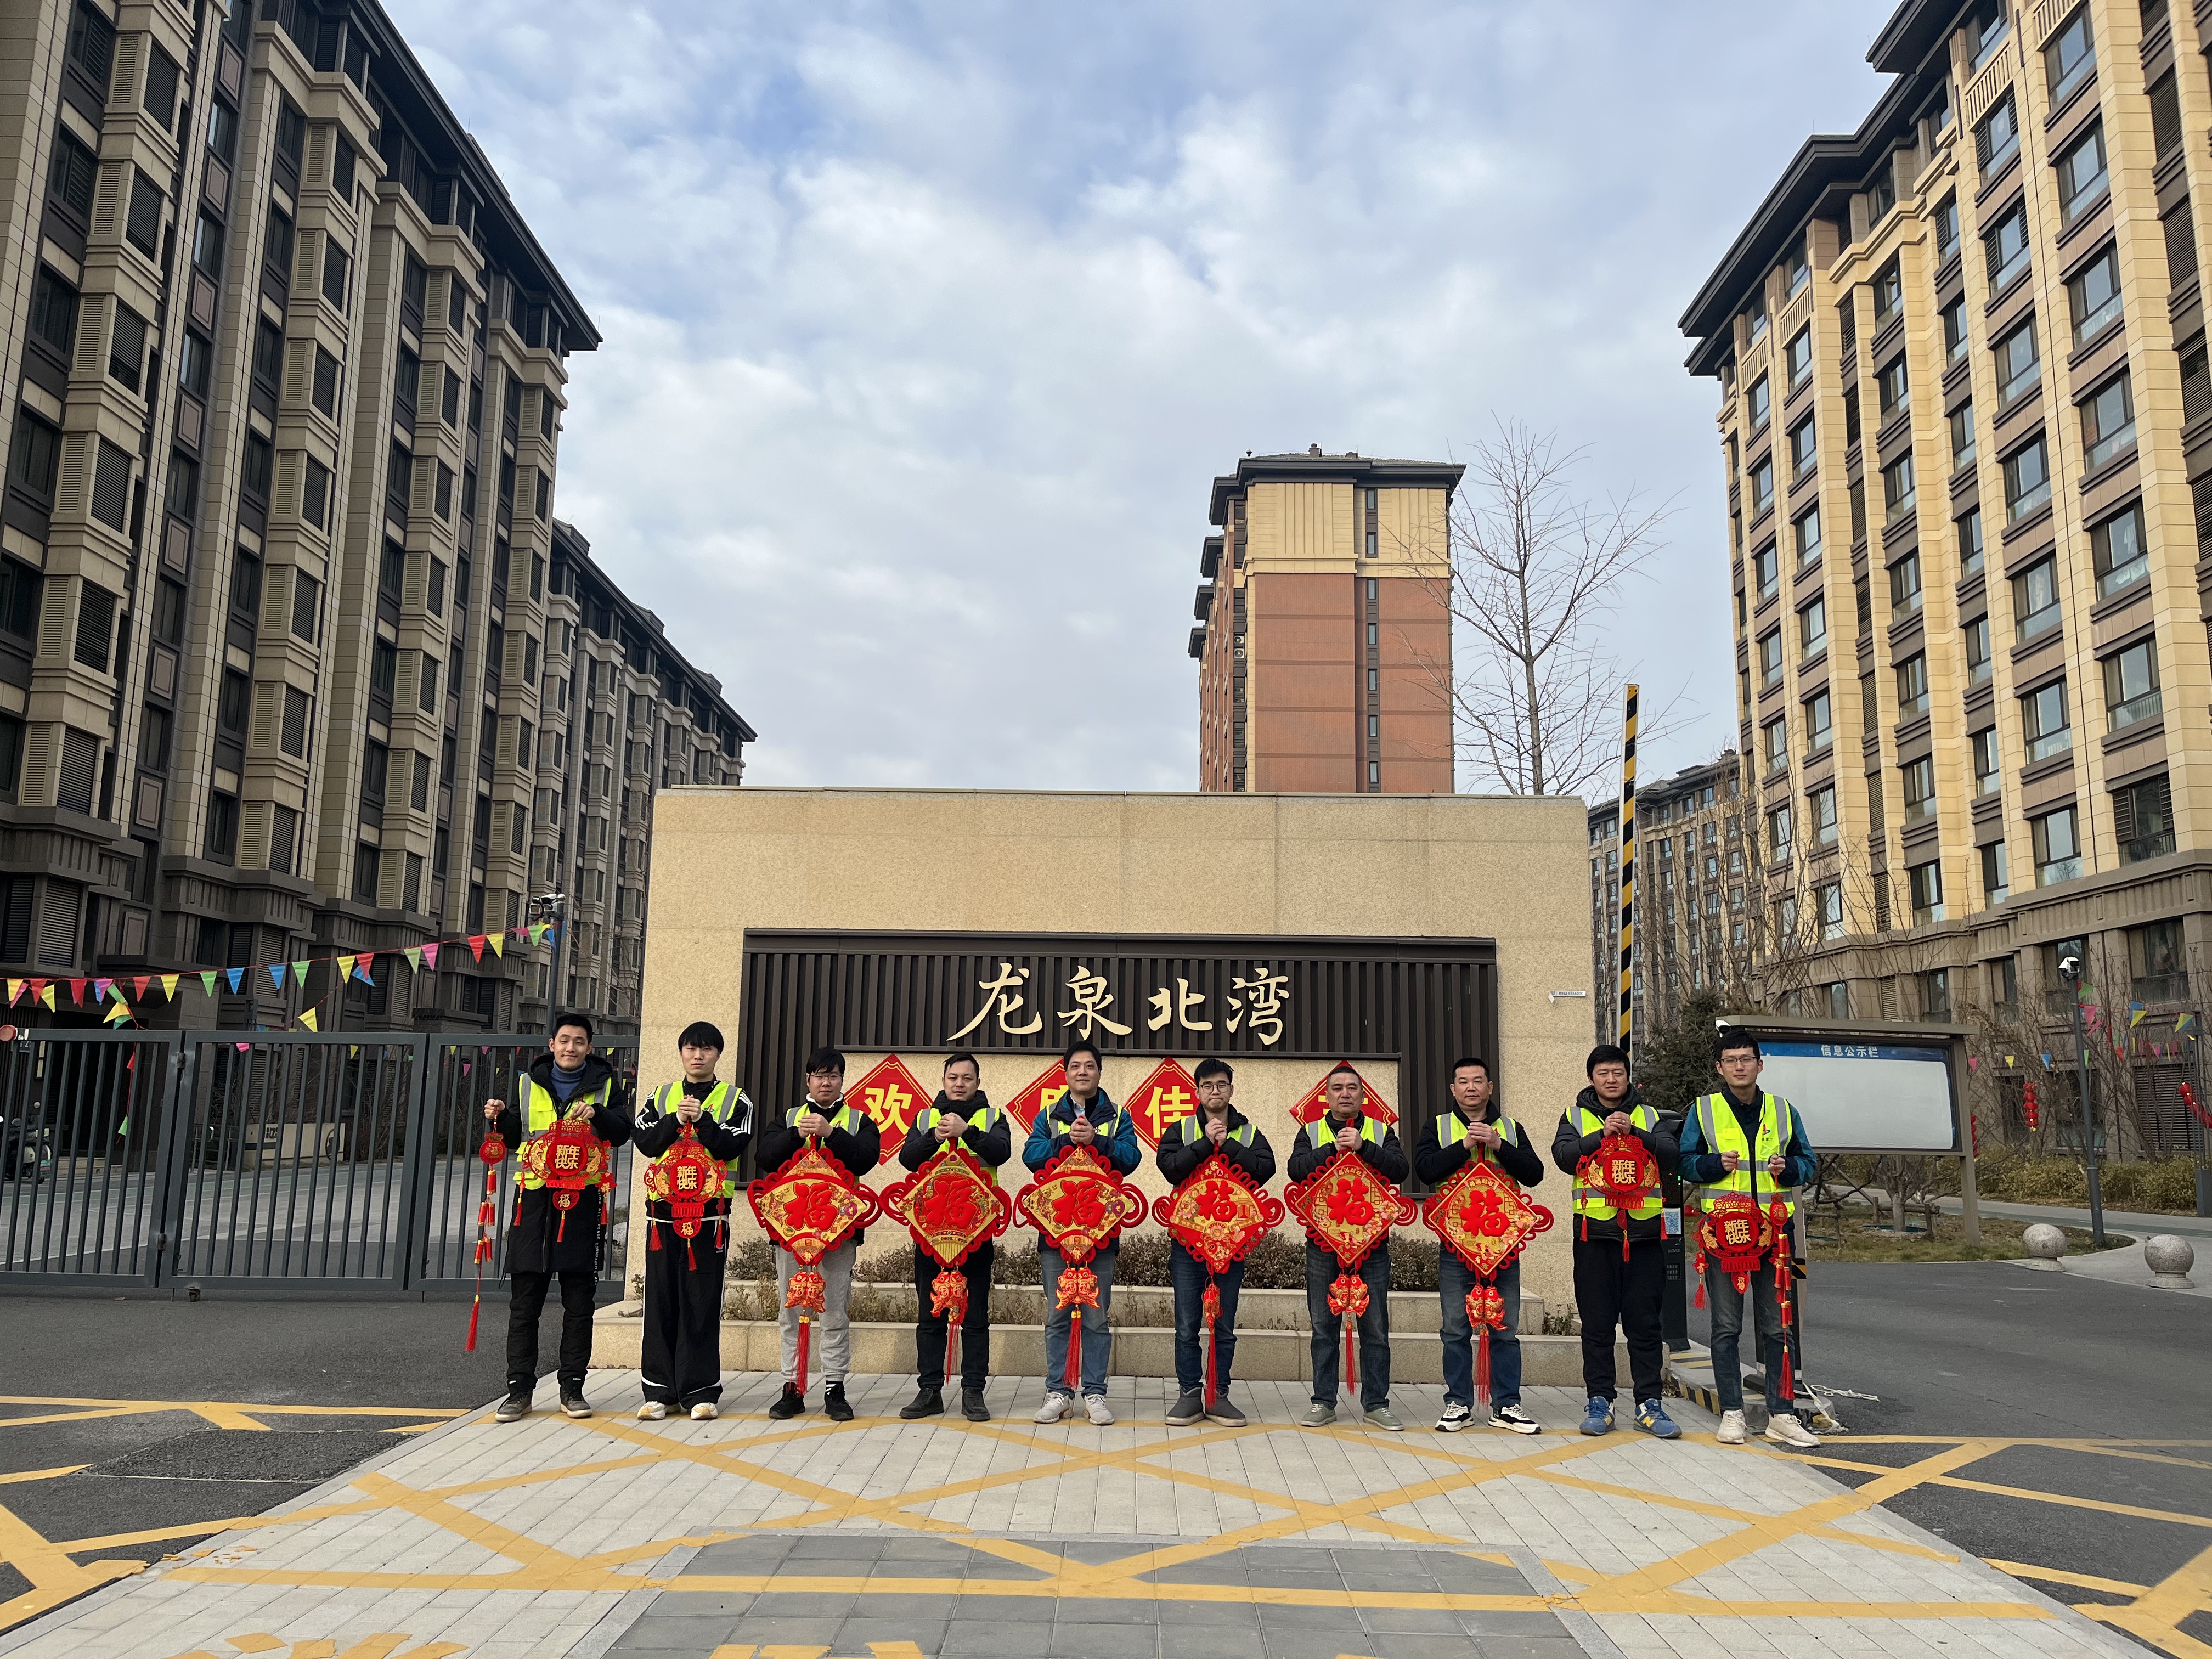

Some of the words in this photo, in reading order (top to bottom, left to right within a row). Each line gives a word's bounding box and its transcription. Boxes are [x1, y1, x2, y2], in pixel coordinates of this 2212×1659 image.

[947, 962, 1289, 1046] 龙泉北湾
[1821, 1044, 1879, 1058] 信息公示栏
[864, 1084, 912, 1135] 欢
[1144, 1086, 1194, 1138] 佳
[556, 1144, 580, 1159] 新年
[555, 1157, 578, 1169] 快乐
[1612, 1159, 1635, 1173] 新年
[676, 1165, 697, 1180] 新年
[1612, 1172, 1636, 1184] 快乐
[677, 1178, 697, 1190] 快乐
[558, 1194, 570, 1207] 福
[784, 1182, 839, 1231] 福
[925, 1179, 977, 1229] 福
[1052, 1179, 1106, 1229] 福
[1195, 1180, 1237, 1222] 福
[1327, 1178, 1374, 1226] 福
[1460, 1189, 1510, 1237] 福
[681, 1222, 693, 1236] 福
[1724, 1219, 1749, 1232] 新年
[1726, 1231, 1751, 1245] 快乐
